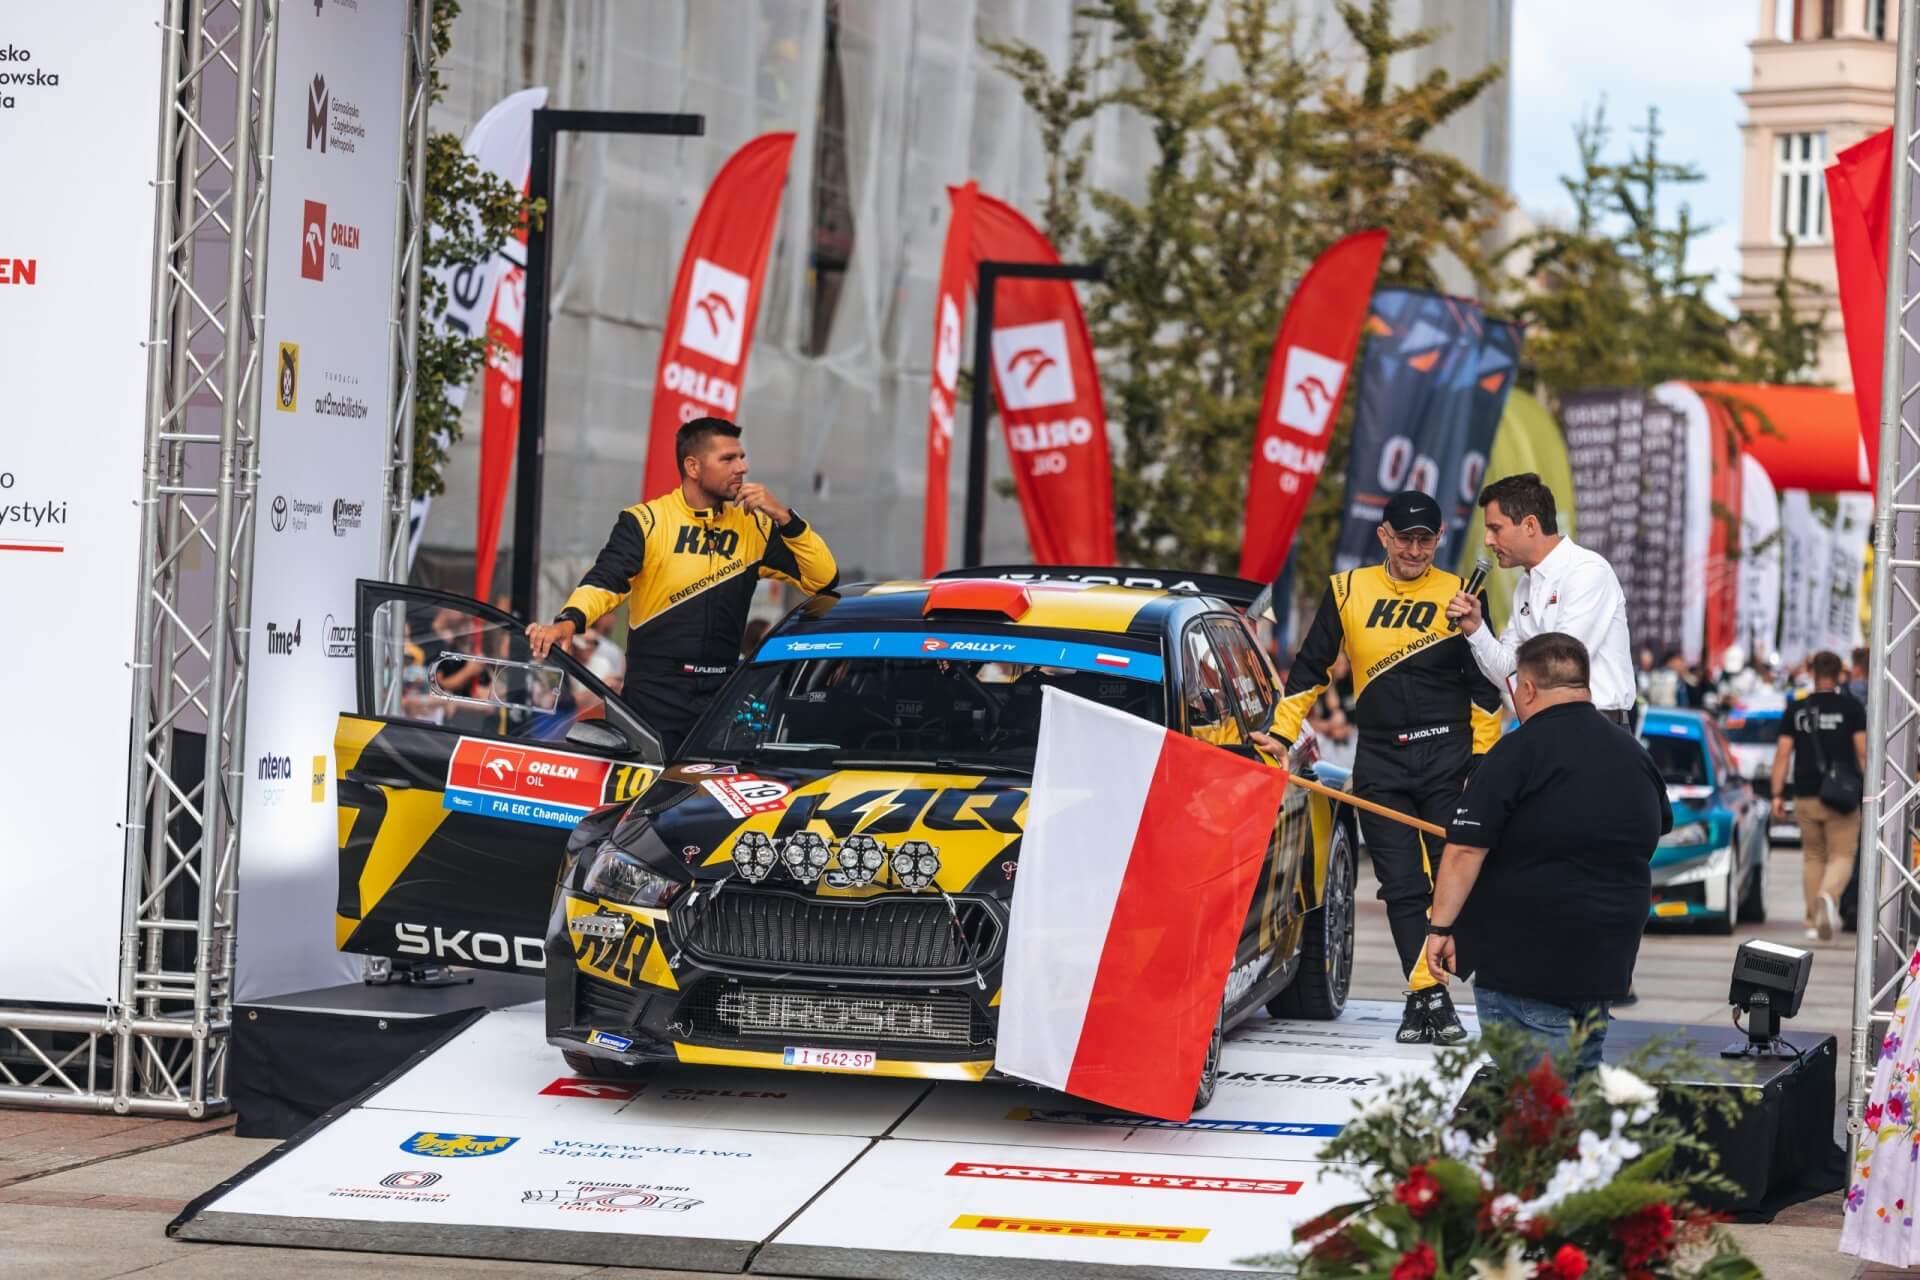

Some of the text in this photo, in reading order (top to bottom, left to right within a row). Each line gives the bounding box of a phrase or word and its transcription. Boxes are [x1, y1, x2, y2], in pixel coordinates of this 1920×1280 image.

[330, 224, 360, 250] ORLEN
[950, 641, 1001, 652] RALLY
[258, 752, 291, 780] interia
[528, 762, 578, 779] ORLEN
[526, 775, 544, 787] OIL
[740, 783, 782, 798] 19
[493, 801, 509, 813] FIA
[512, 804, 531, 816] ERC
[668, 1088, 789, 1099] ORLEN
[552, 1140, 752, 1158] Województwo
[959, 1165, 1288, 1192] MRF TYRES
[976, 1217, 1187, 1239] PIRELLI
